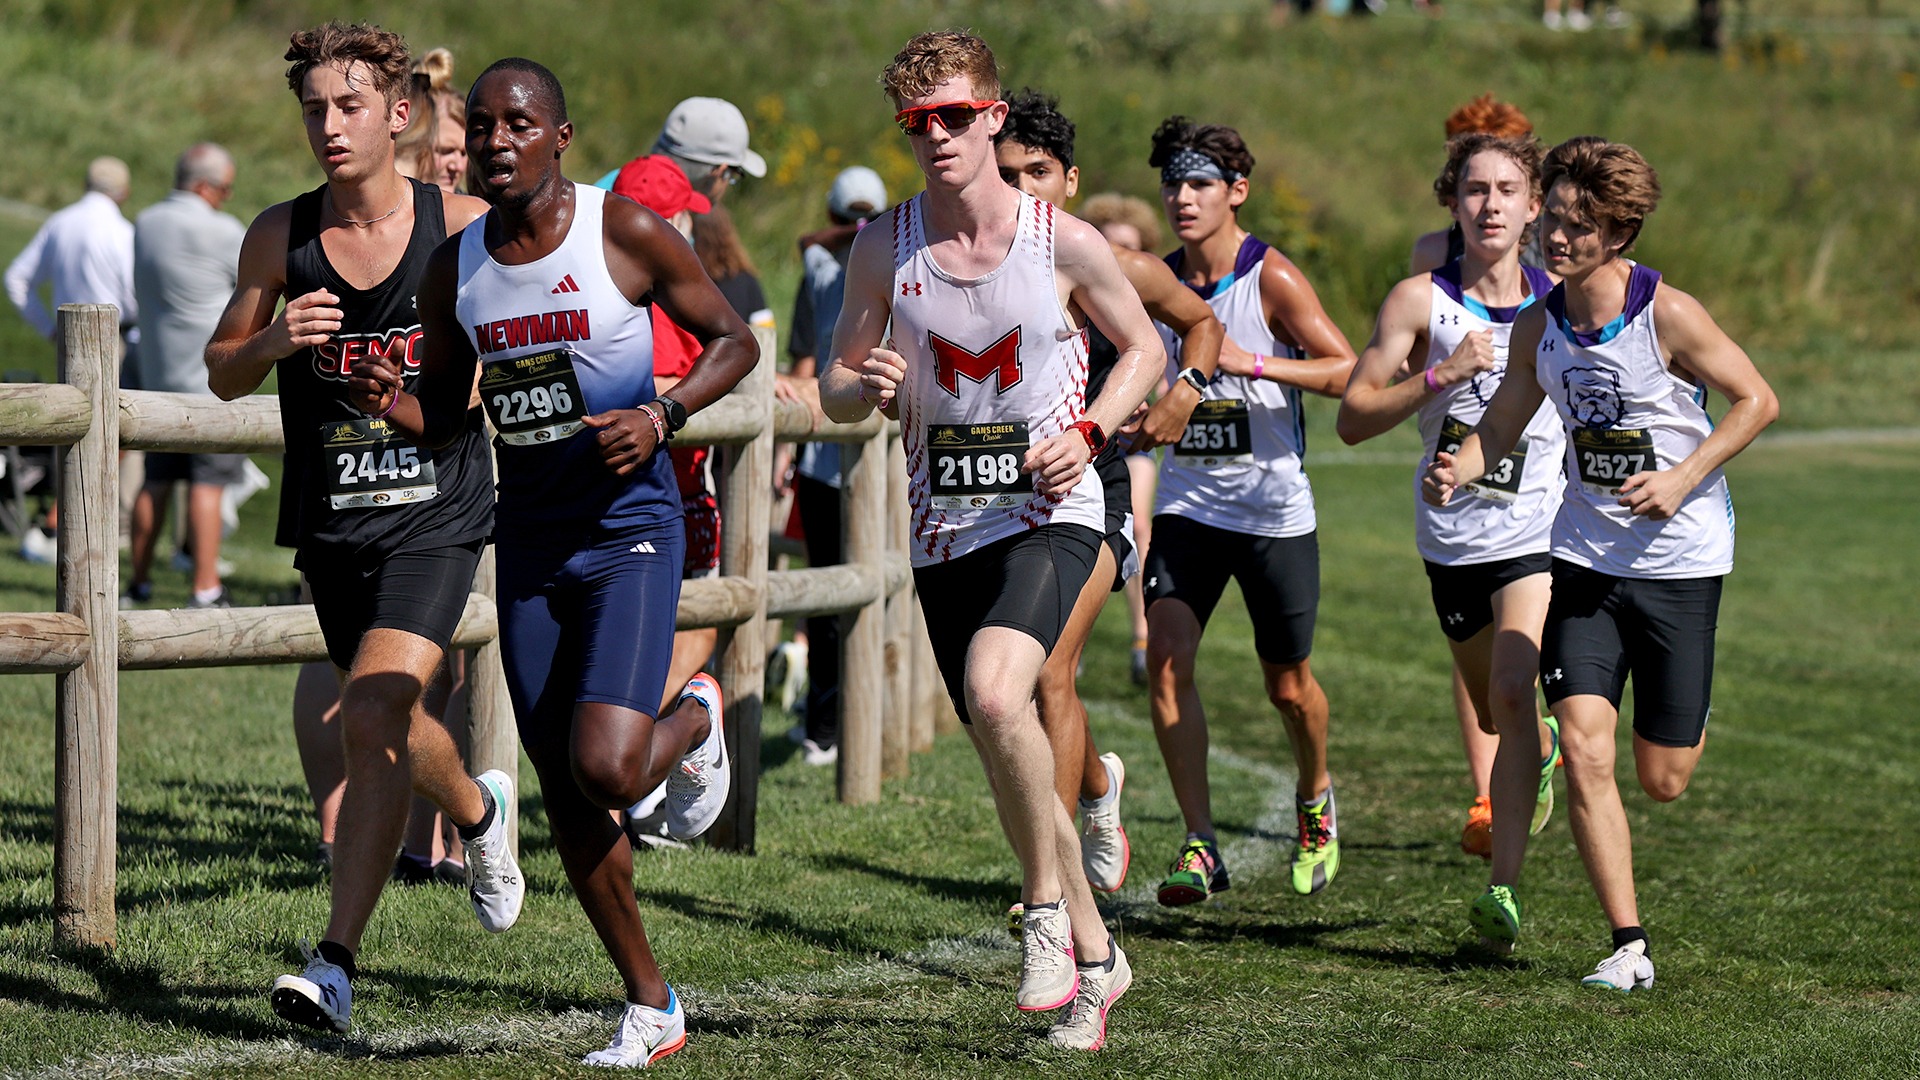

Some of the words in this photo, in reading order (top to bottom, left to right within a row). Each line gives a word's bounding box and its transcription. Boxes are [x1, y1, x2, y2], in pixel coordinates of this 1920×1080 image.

[473, 309, 591, 355] NEWMAN
[515, 357, 536, 369] GANS
[535, 353, 558, 365] CREEK
[927, 323, 1023, 400] M
[492, 382, 573, 425] 2296
[369, 420, 388, 430] GAN
[970, 426, 991, 435] GANS
[991, 425, 1015, 434] CREEK
[982, 433, 1002, 443] Classic
[1180, 422, 1239, 450] 2531
[336, 446, 421, 485] 2445
[938, 453, 1019, 486] 2198
[1583, 450, 1646, 479] 2527
